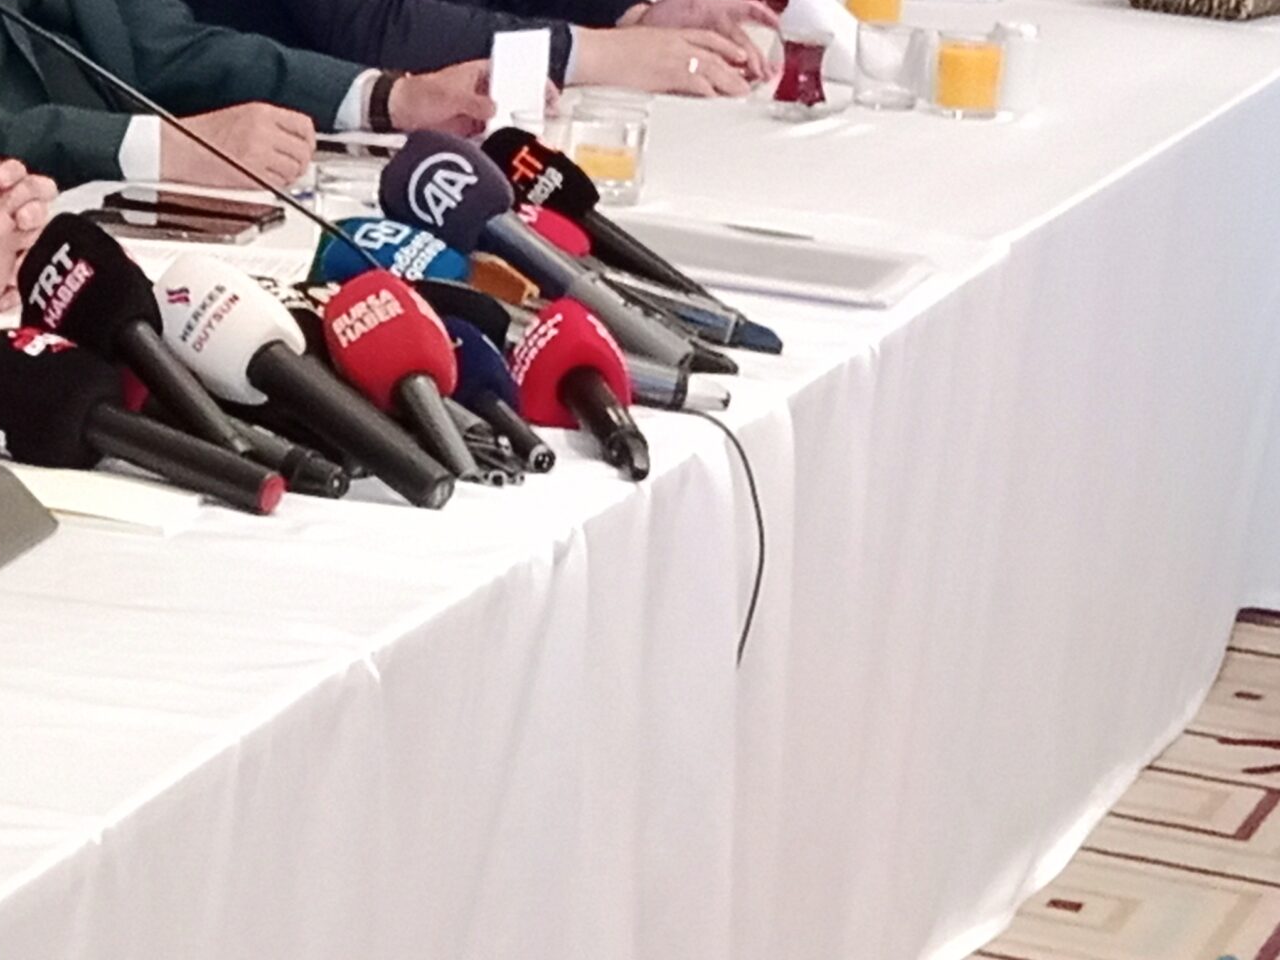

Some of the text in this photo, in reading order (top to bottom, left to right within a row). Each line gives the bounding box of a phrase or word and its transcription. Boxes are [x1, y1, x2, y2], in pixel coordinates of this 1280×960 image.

[28, 242, 74, 310] TRT
[43, 260, 95, 329] HABER
[180, 285, 227, 342] HERKES
[192, 293, 240, 352] DUYSUN
[334, 299, 405, 349] HABER
